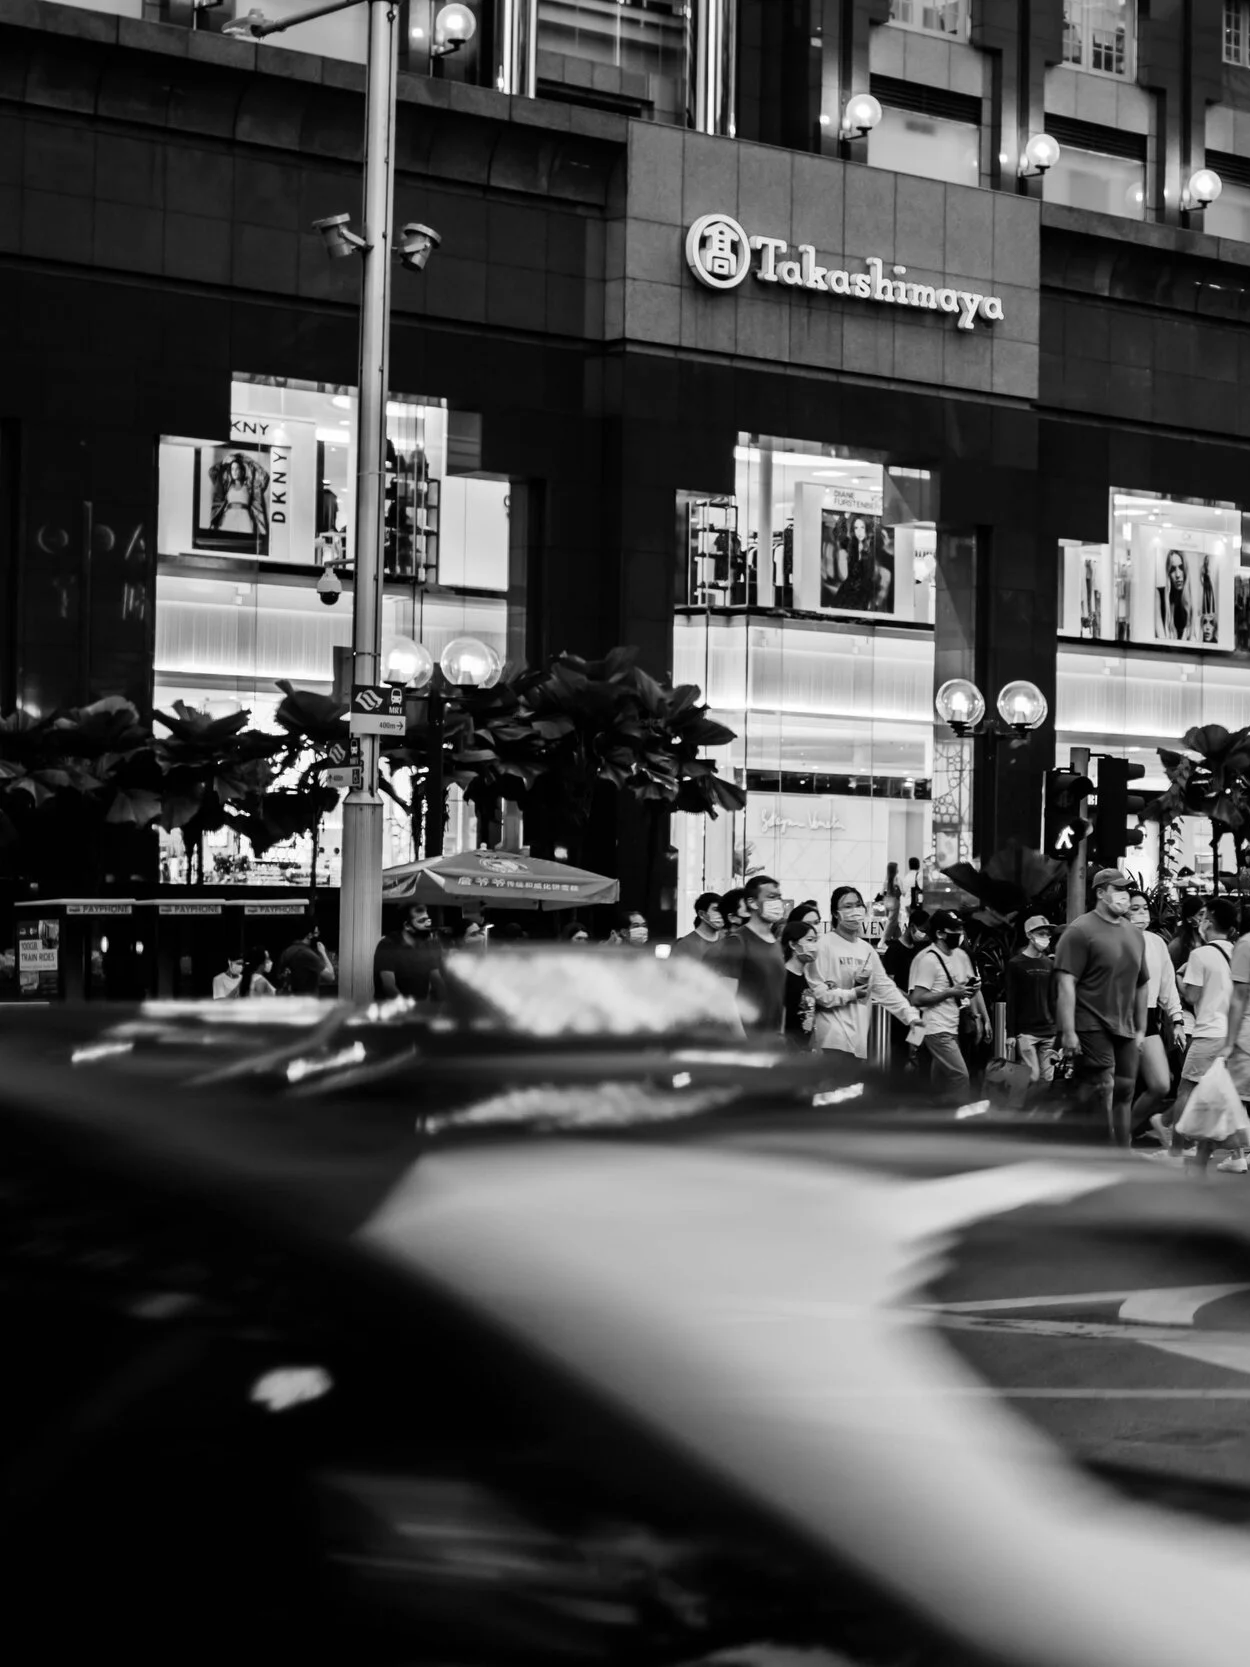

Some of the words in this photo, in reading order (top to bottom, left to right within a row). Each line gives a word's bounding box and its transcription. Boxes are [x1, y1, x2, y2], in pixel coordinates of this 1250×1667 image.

[750, 236, 1004, 329] Takashimaya
[231, 421, 270, 435] KNY
[272, 451, 287, 523] DKNY
[389, 706, 402, 714] MRT
[83, 904, 130, 913] PAYPHONE
[174, 904, 219, 913] PAYPHONE
